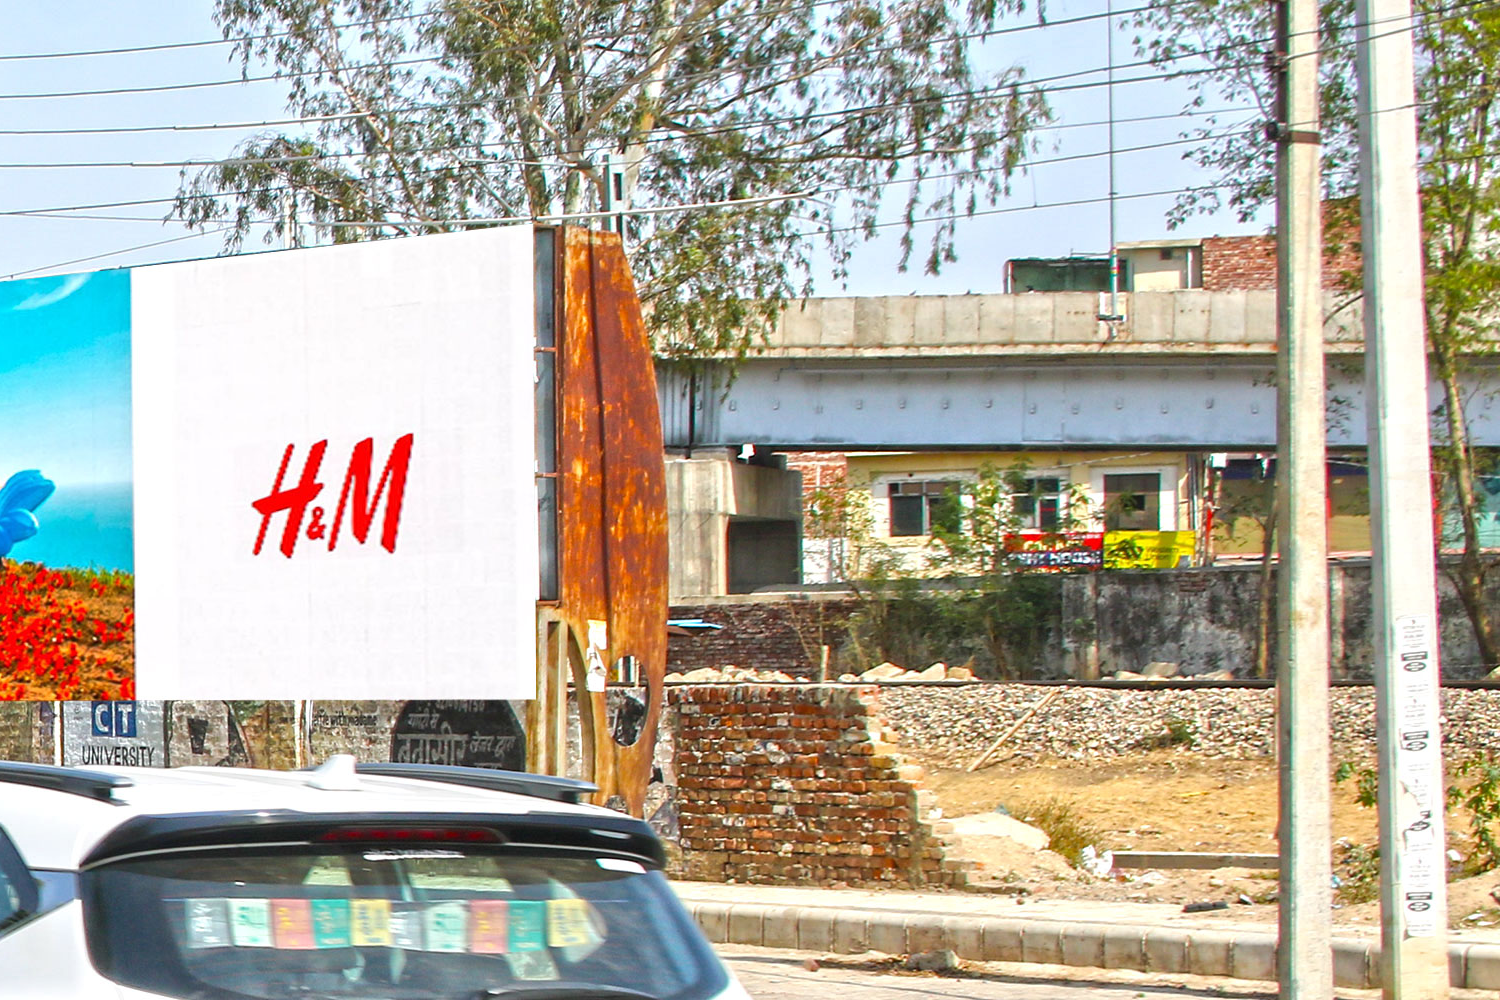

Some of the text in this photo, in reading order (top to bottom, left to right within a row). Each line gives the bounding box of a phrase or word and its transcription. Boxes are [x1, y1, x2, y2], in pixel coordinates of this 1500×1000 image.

[252, 433, 414, 559] H&M
[94, 705, 134, 733] CT
[82, 746, 155, 767] UNIVERSITY
